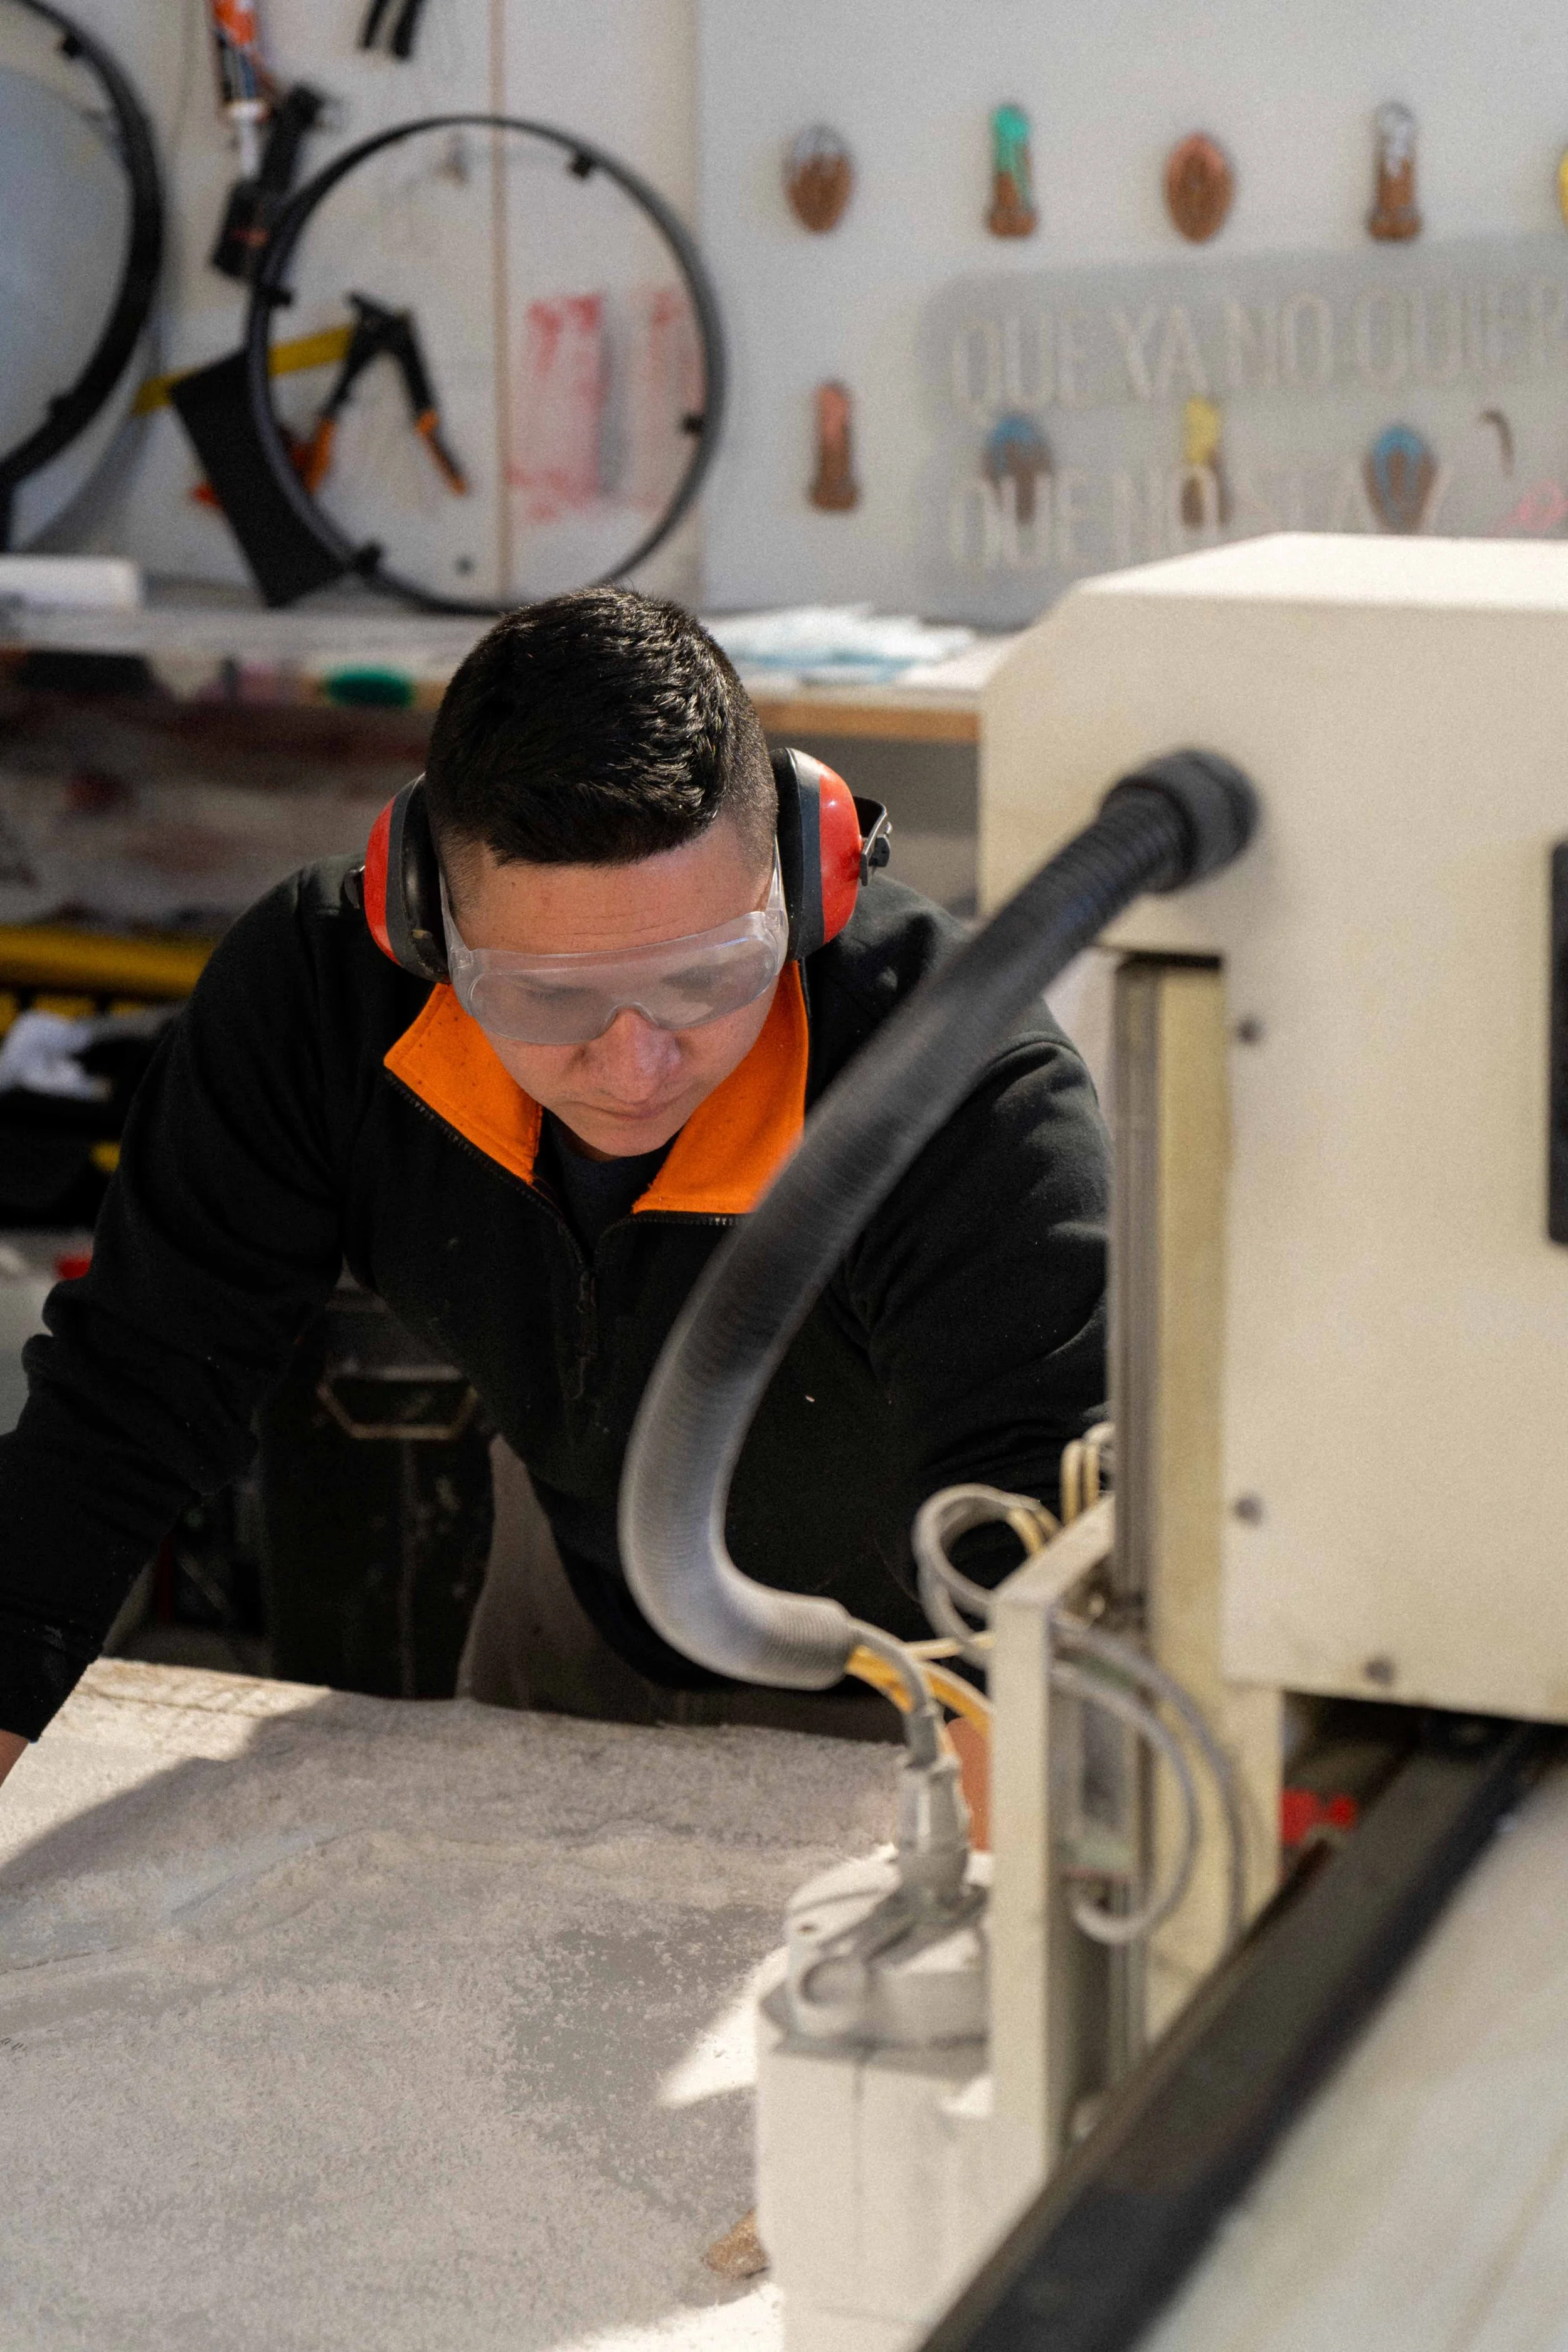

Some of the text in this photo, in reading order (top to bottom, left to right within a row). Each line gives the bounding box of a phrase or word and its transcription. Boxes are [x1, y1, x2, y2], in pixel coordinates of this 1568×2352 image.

[950, 305, 1094, 428] QUE
[1108, 297, 1210, 400] YA
[1222, 290, 1334, 394] NO
[948, 465, 1090, 573] QUE
